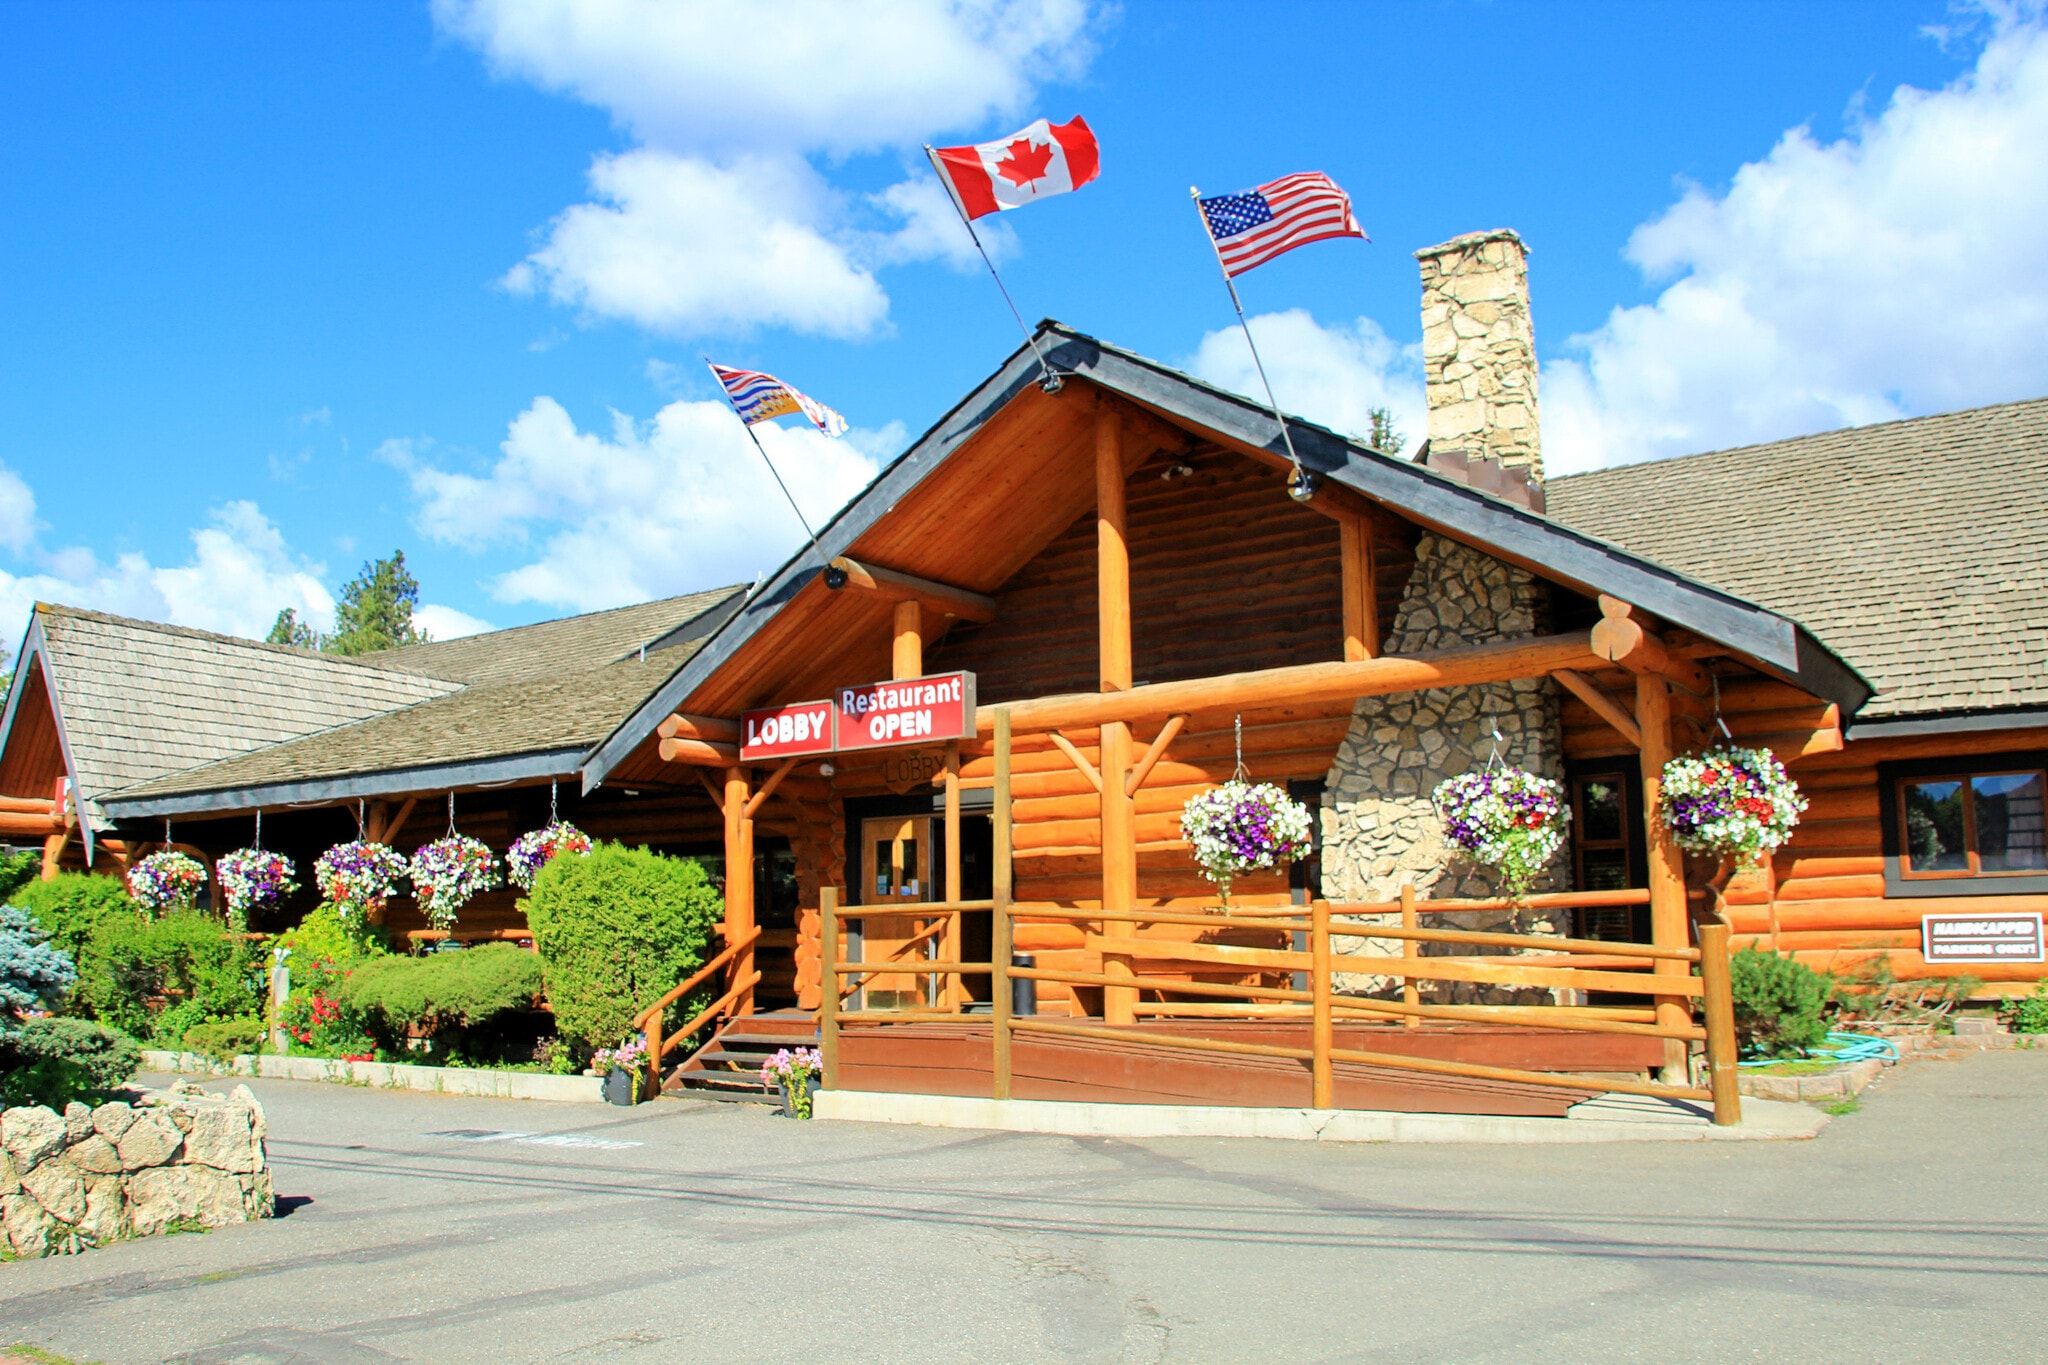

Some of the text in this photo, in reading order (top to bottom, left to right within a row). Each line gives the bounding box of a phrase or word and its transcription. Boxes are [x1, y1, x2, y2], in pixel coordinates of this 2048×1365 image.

[843, 678, 961, 715] Restaurant
[748, 710, 826, 746] LOBBY
[869, 709, 932, 740] OPEN
[885, 755, 946, 783] LOBBY
[1933, 922, 2034, 935] HANDICAPPED
[1933, 944, 1993, 954] PARKING
